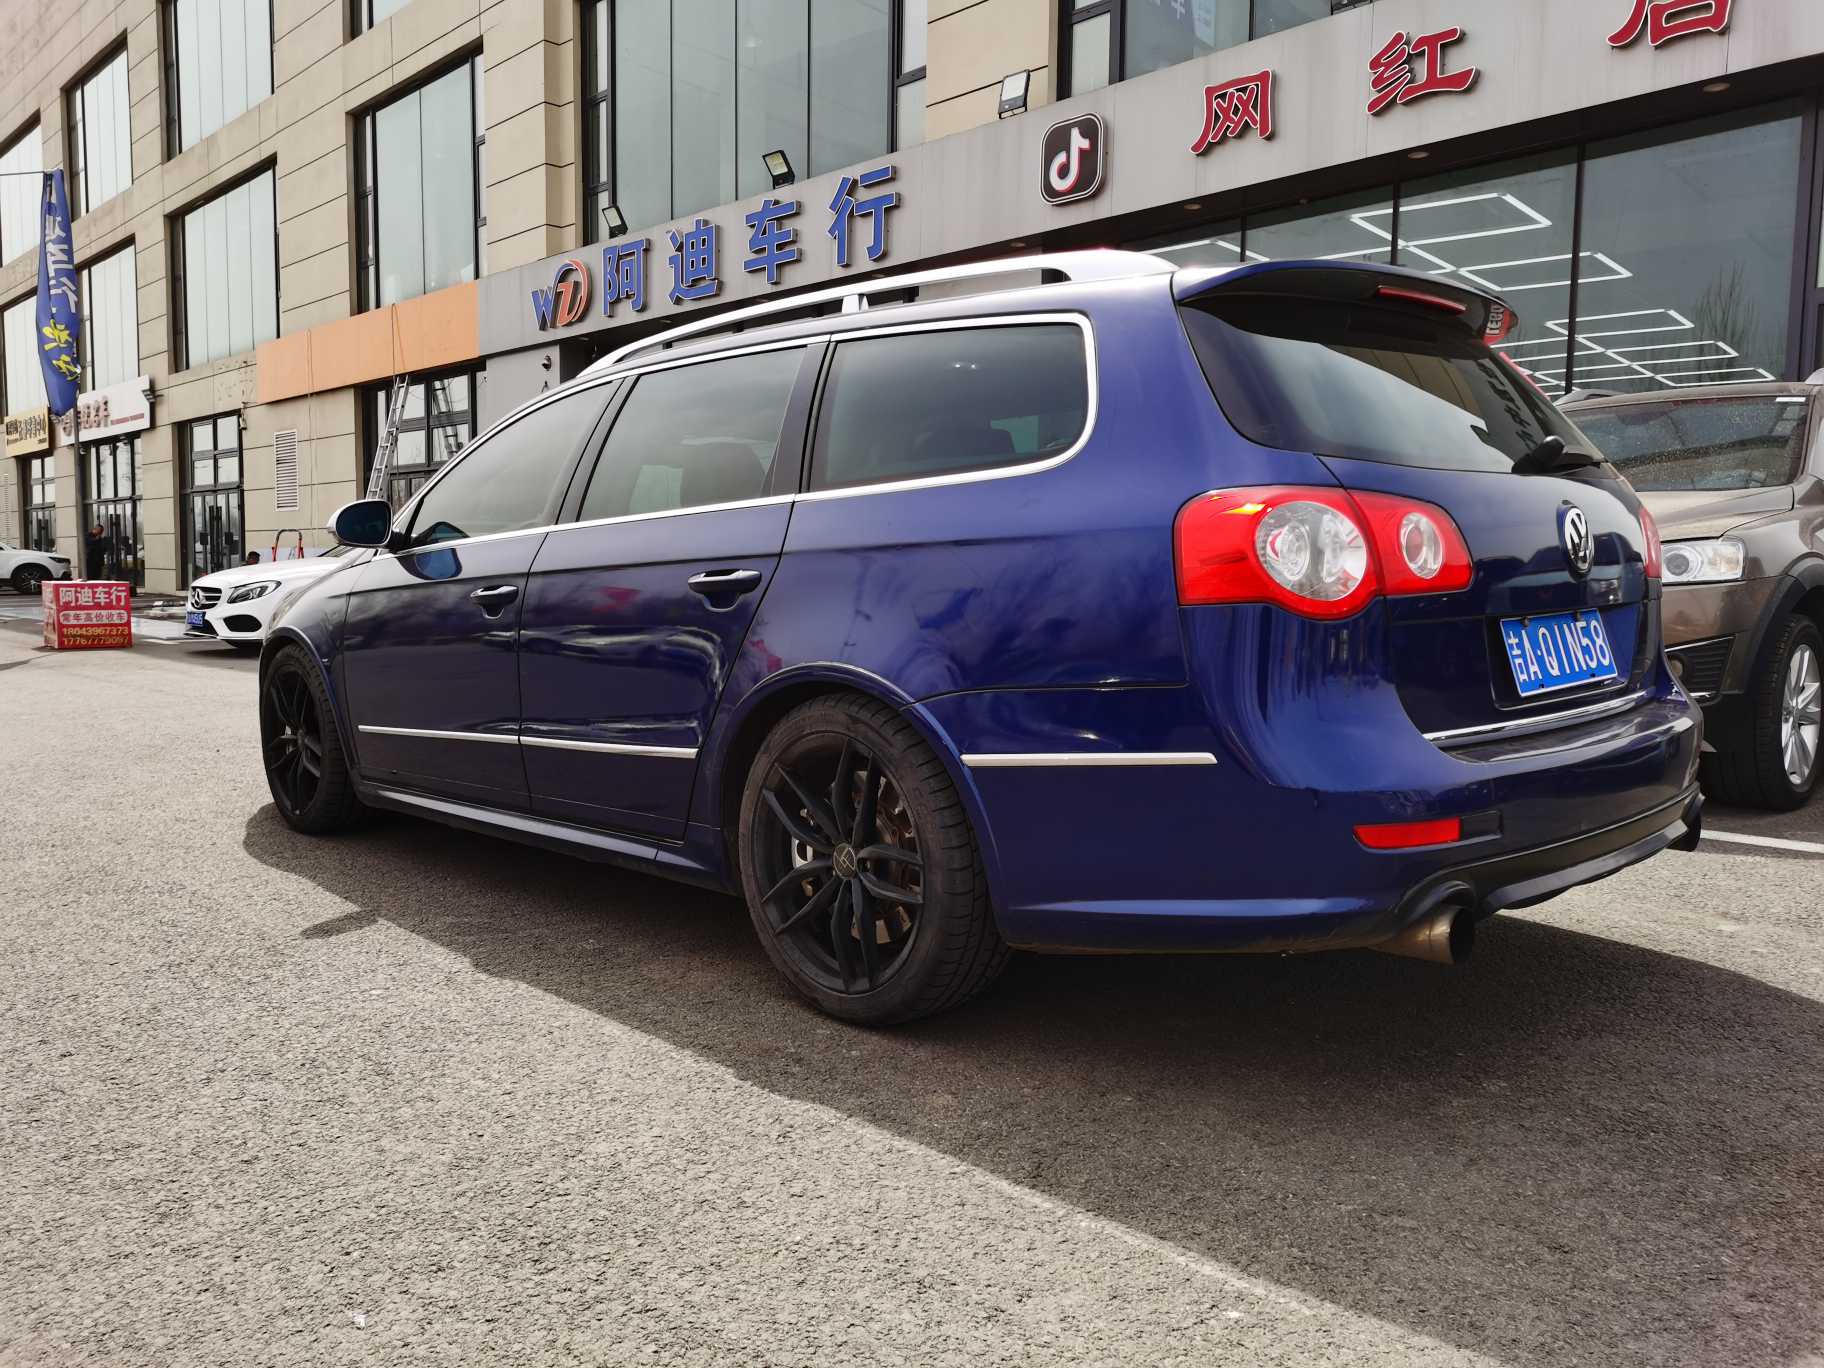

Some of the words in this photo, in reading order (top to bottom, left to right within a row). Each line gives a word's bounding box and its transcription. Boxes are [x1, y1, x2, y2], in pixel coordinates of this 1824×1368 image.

[602, 164, 897, 317] 阿迪车行
[59, 586, 127, 606] 阿迪车行
